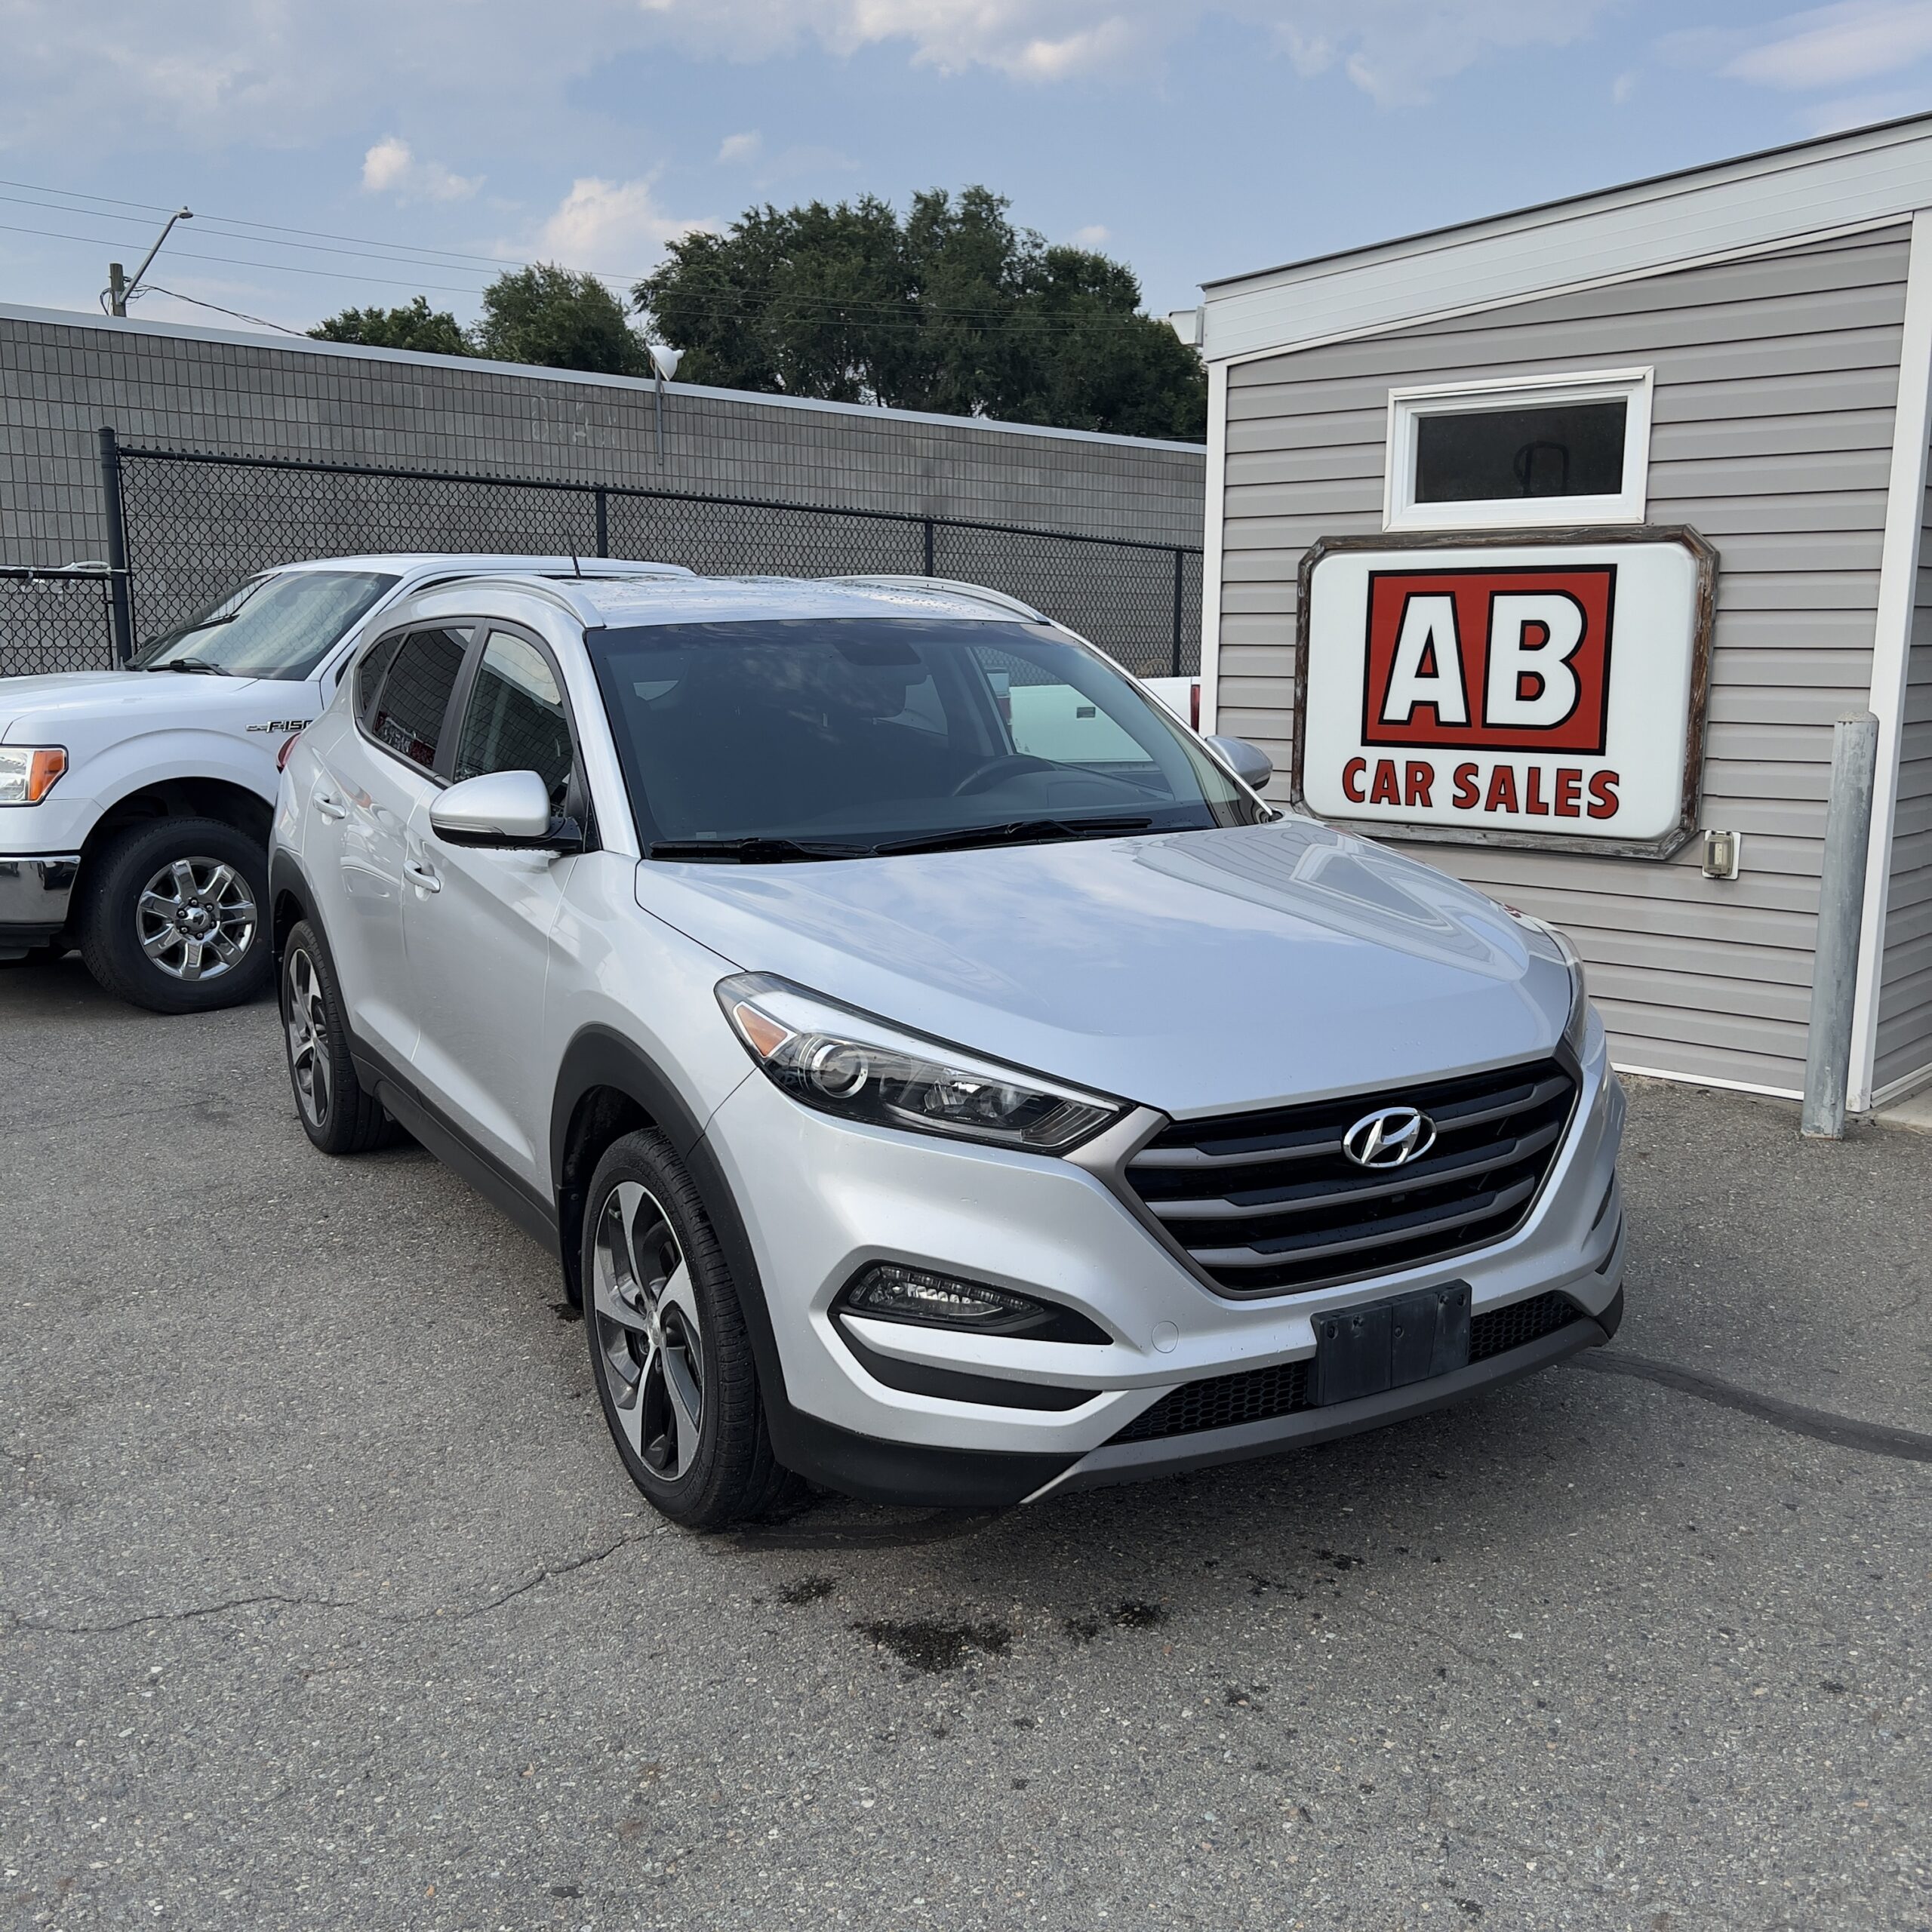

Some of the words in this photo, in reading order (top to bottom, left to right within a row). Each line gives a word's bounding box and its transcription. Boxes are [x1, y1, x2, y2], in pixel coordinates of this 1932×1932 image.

[1377, 589, 1588, 730] AB
[1342, 757, 1435, 807] CAR
[1452, 762, 1620, 820] SALES
